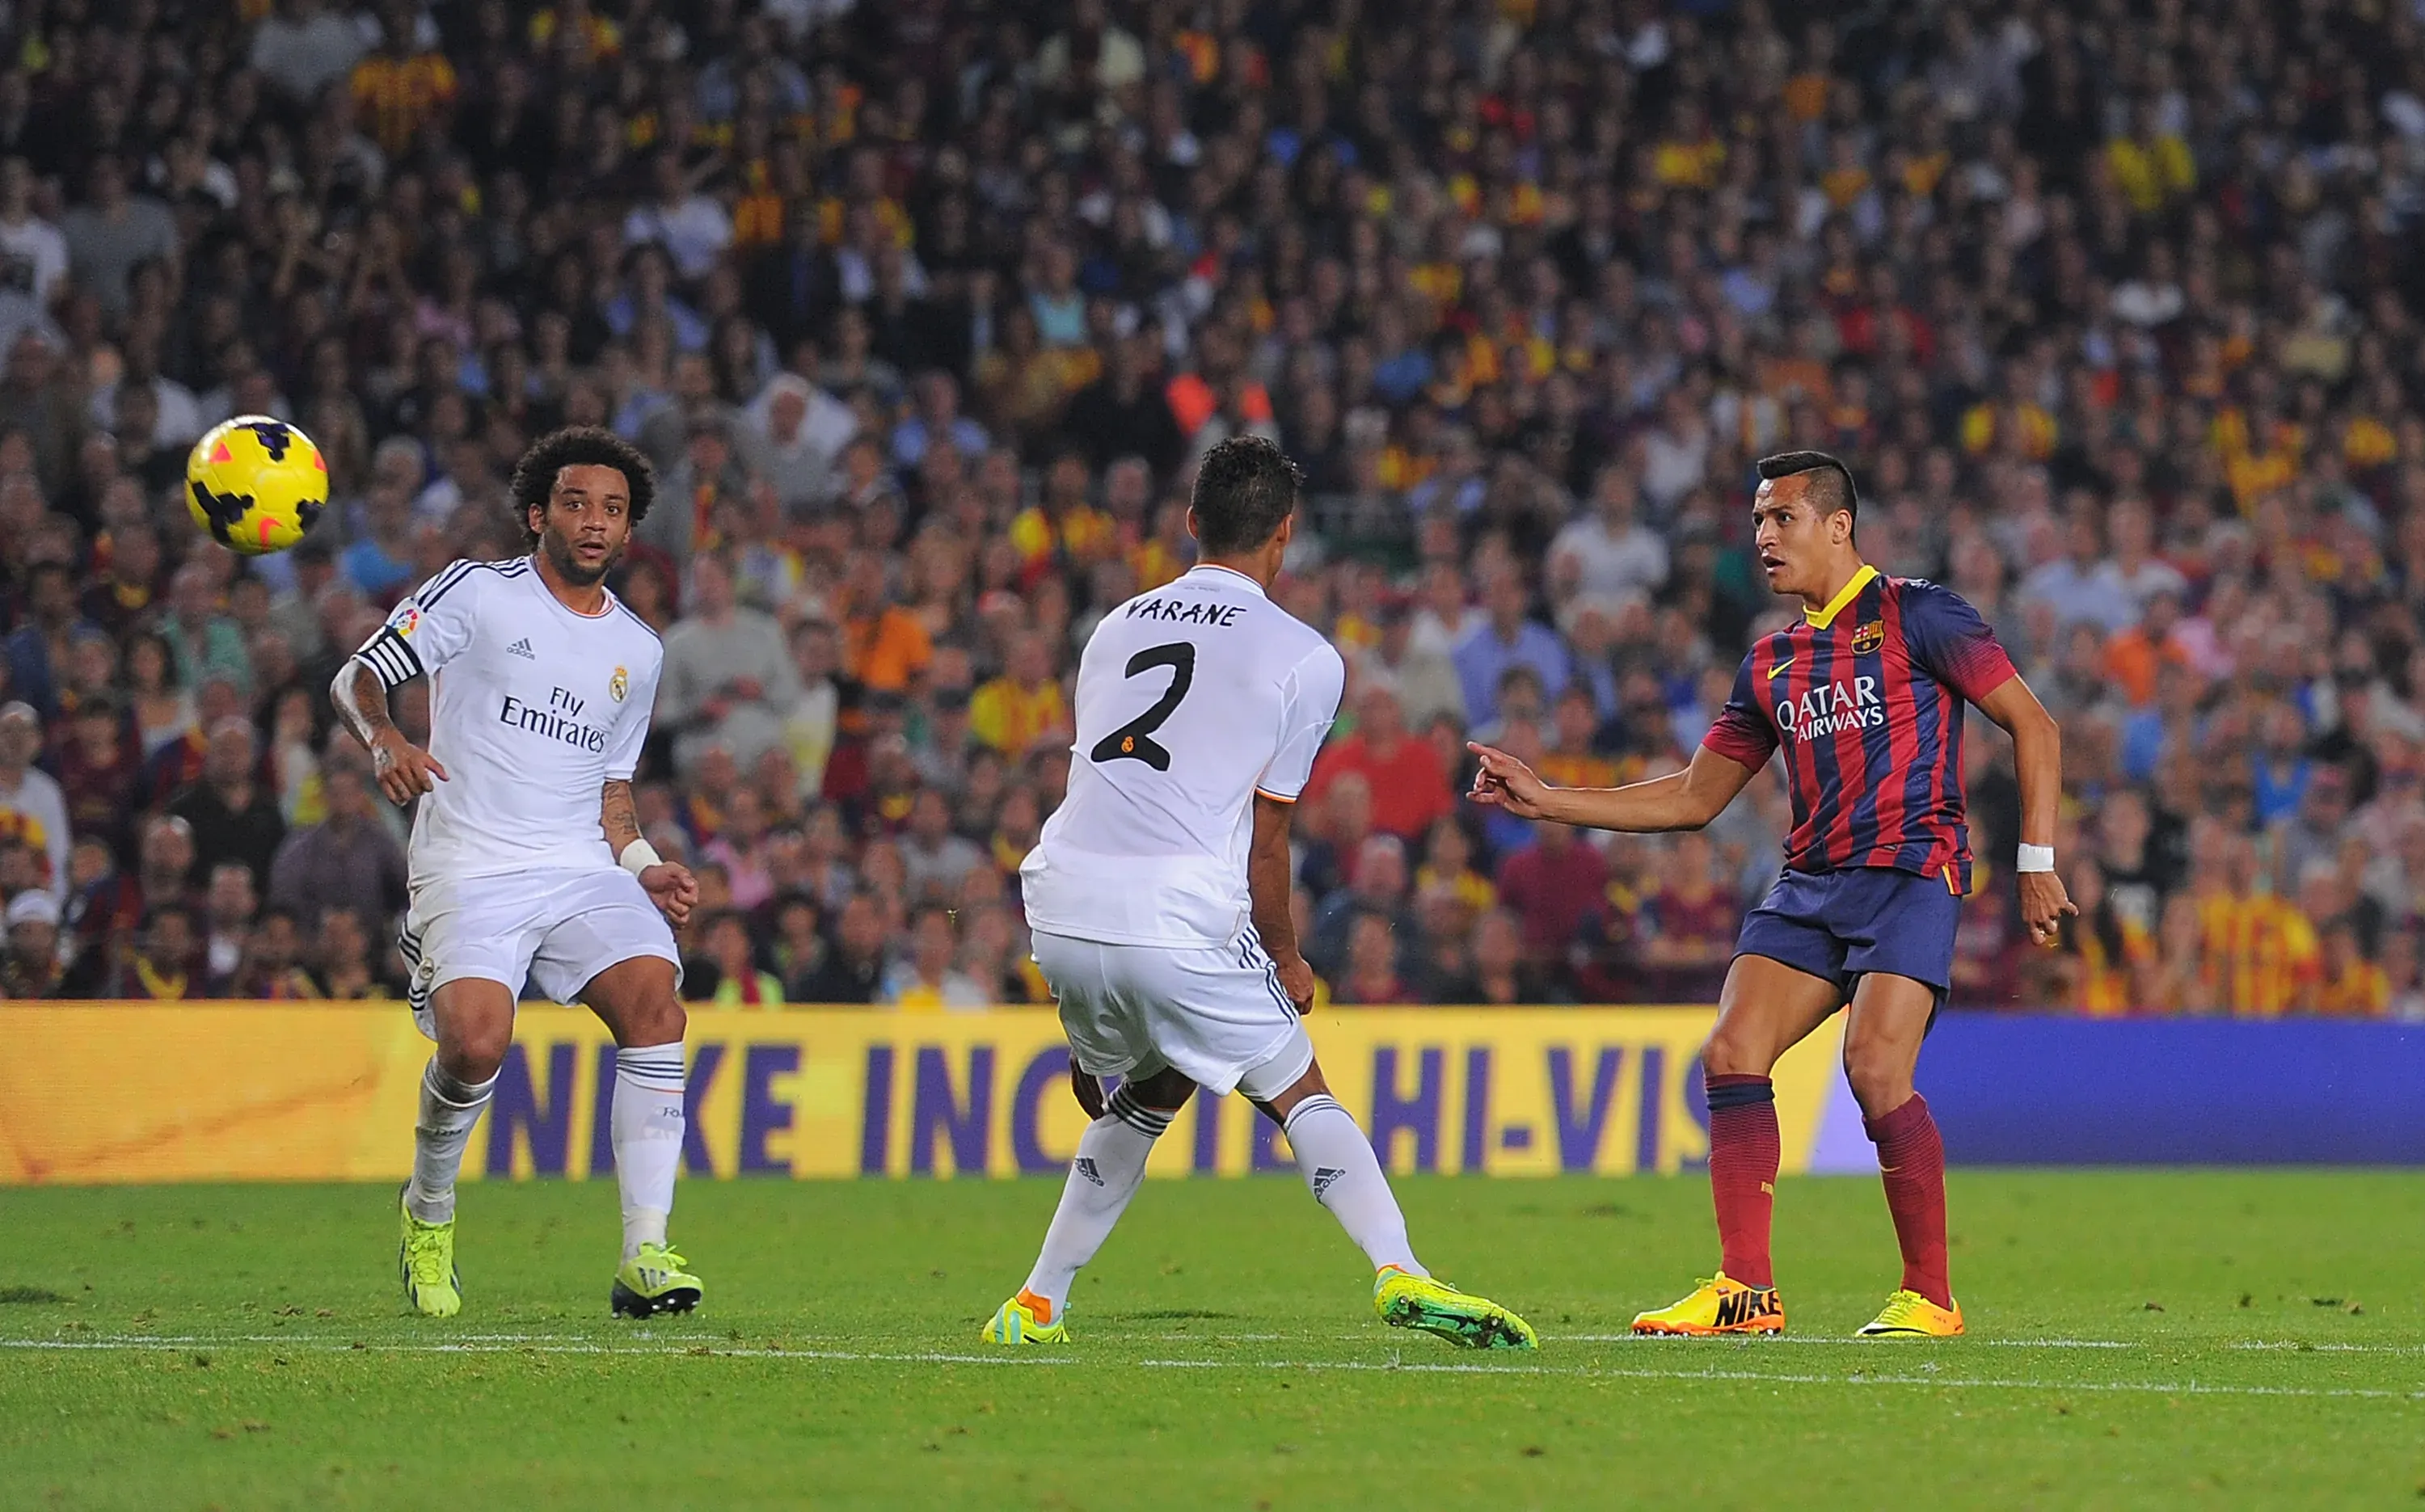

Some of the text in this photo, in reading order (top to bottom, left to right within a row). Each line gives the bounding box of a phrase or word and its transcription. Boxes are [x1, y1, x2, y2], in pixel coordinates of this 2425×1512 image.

[1125, 598, 1247, 626] VARANE
[550, 686, 584, 717] Fly
[1091, 642, 1196, 772] 2
[1777, 676, 1879, 733] QATAR
[500, 695, 605, 753] Emirates
[1797, 705, 1883, 743] AIRWAYS
[1712, 1288, 1782, 1328] NIKE
